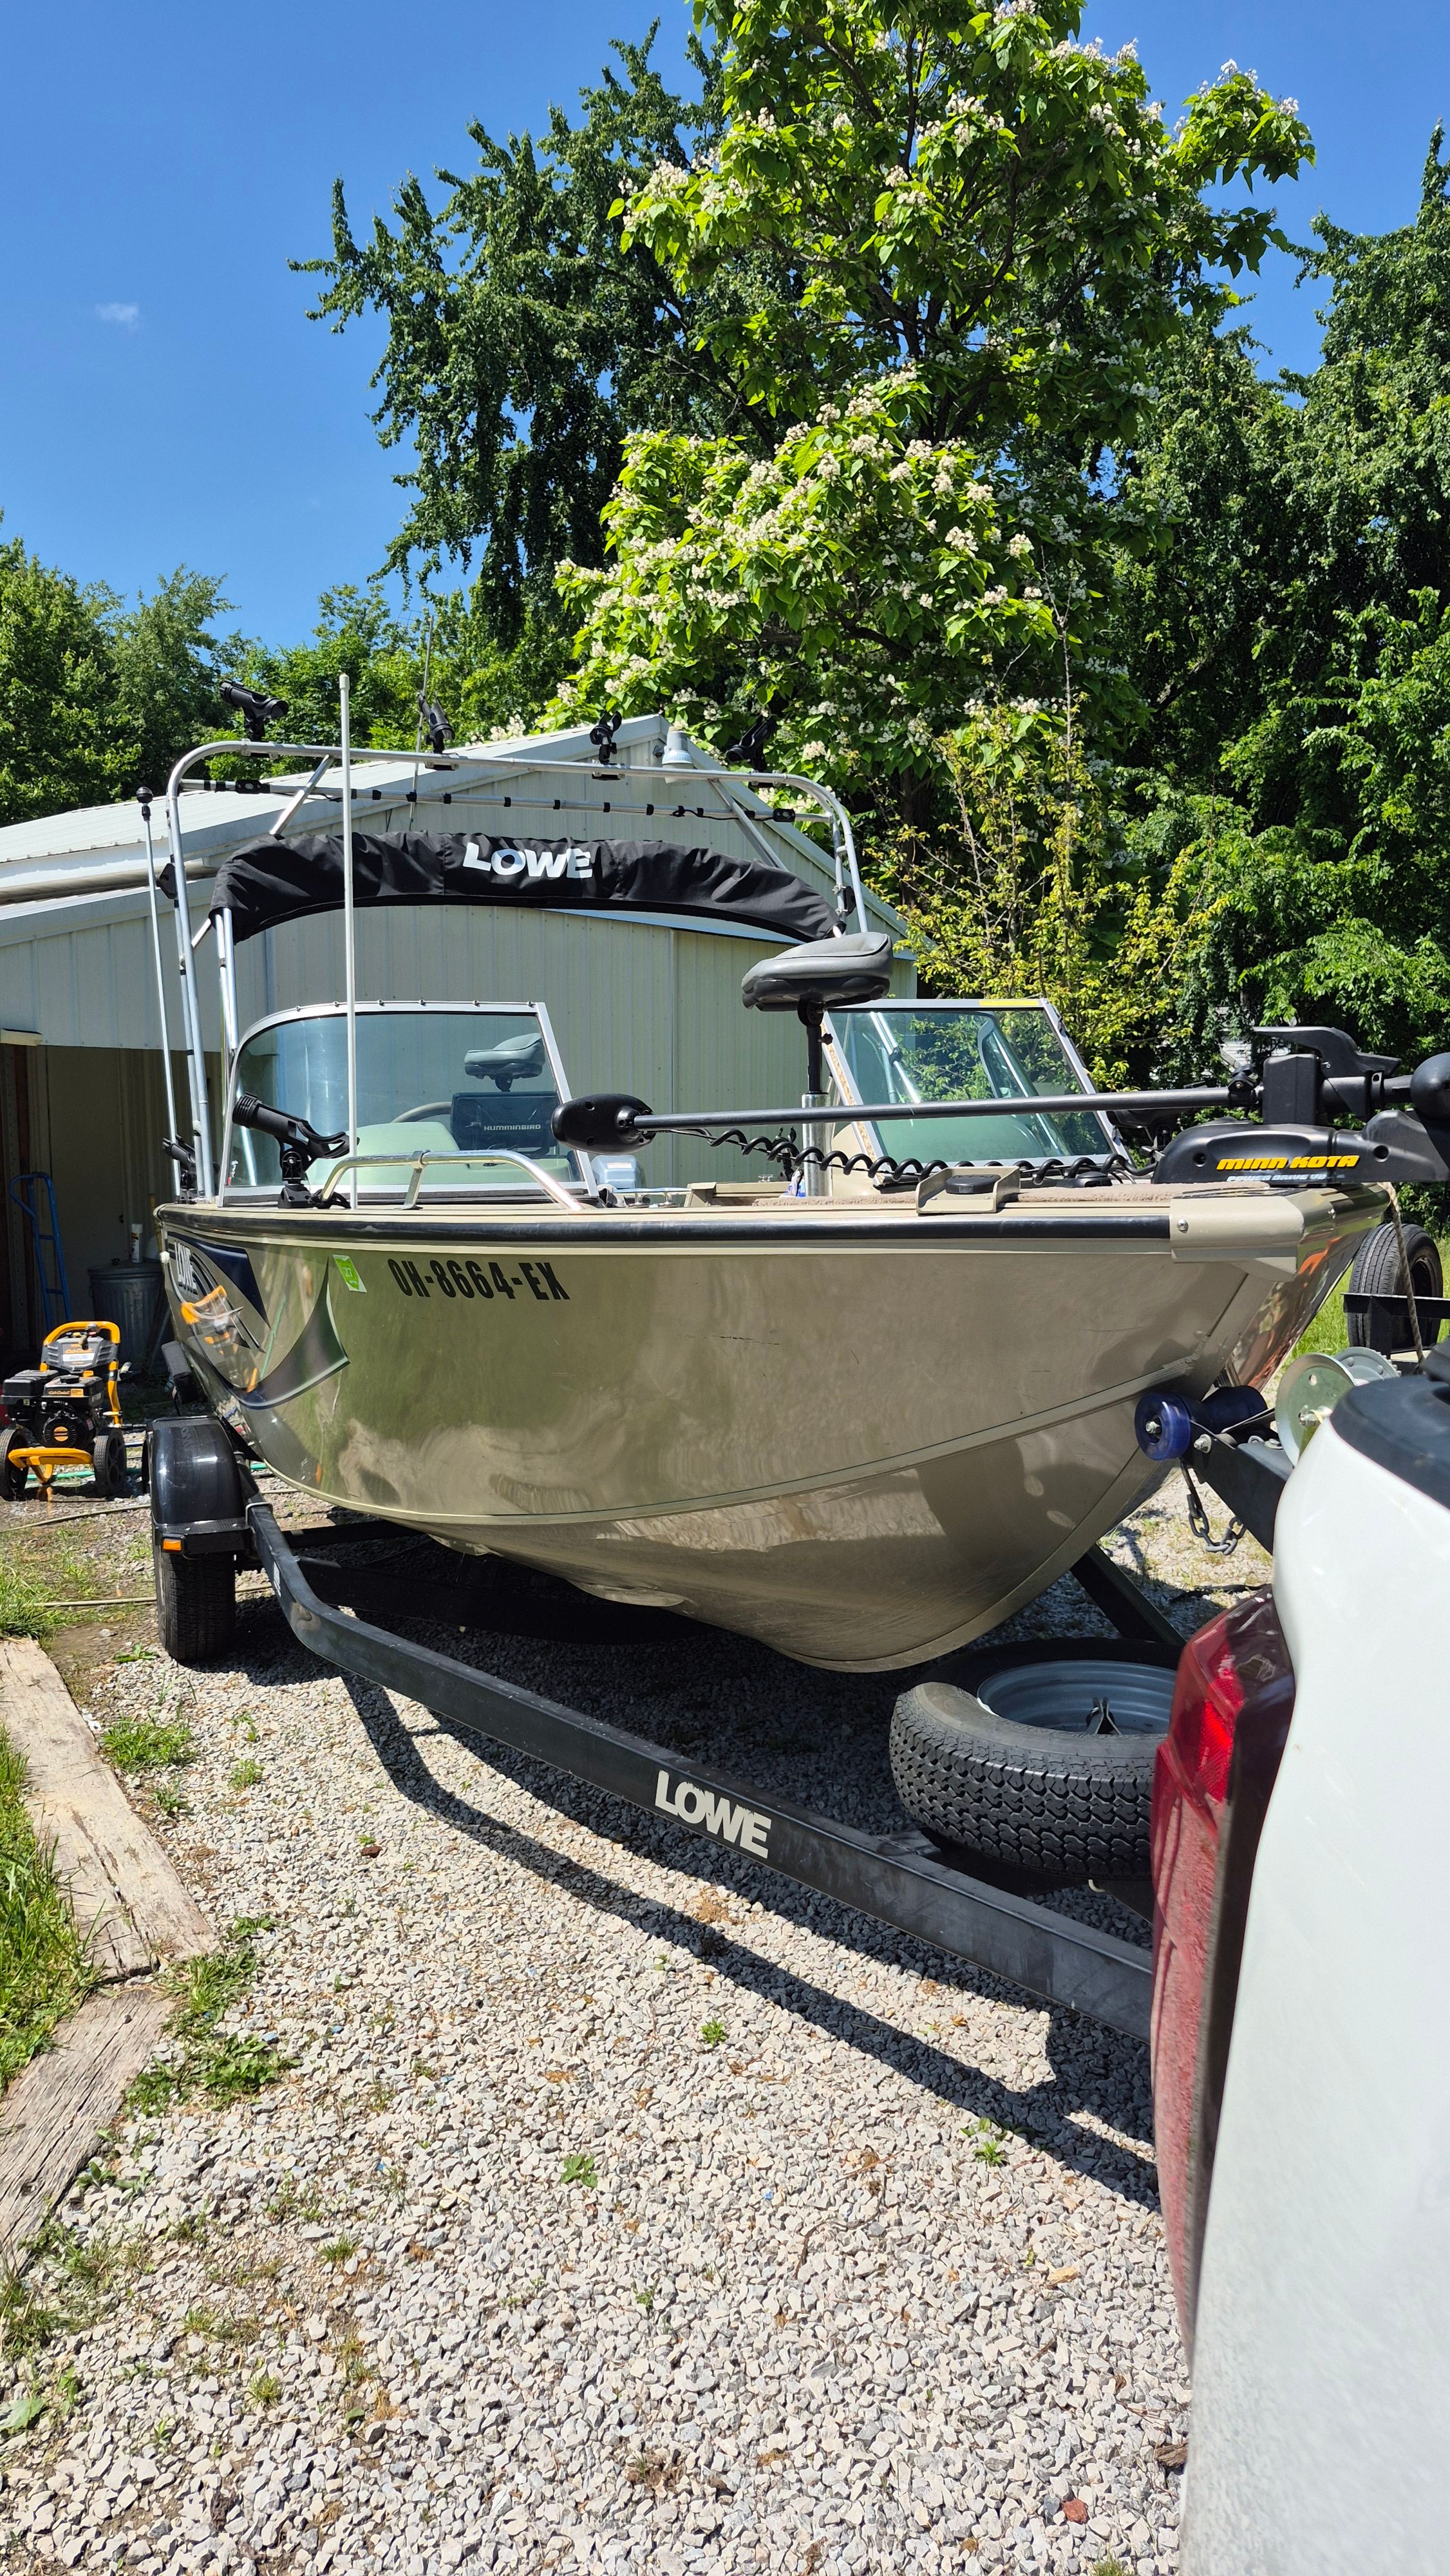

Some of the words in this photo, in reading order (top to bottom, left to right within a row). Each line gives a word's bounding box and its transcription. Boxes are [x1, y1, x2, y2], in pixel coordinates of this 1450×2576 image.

[463, 842, 594, 878] LOWE
[1216, 1157, 1288, 1170] MINN
[1290, 1155, 1361, 1168] KOTA
[388, 1258, 570, 1300] OH-8664-EX
[655, 1770, 772, 1859] LOWE
